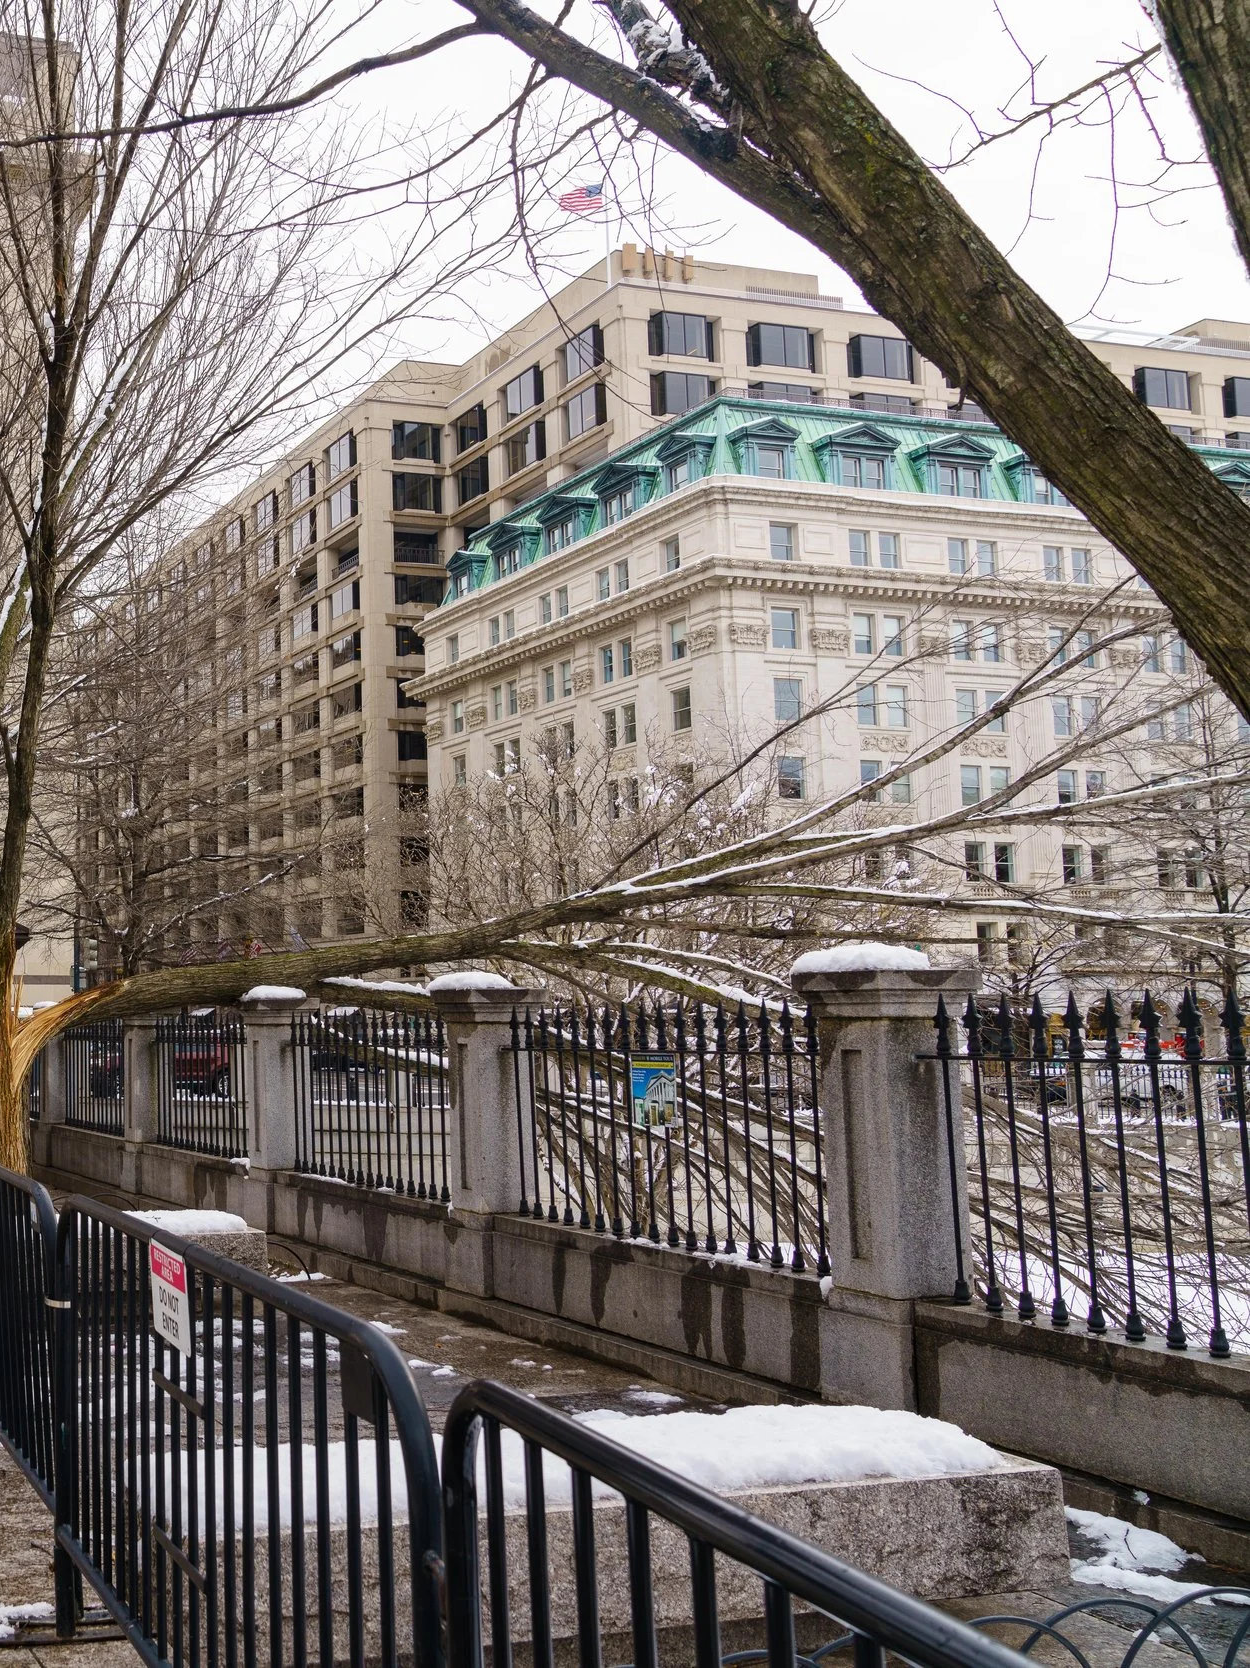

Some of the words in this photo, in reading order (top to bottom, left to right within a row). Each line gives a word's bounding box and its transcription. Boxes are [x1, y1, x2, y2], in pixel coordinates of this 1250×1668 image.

[153, 1247, 181, 1275] RESTRICTED
[161, 1264, 174, 1283] AREA
[159, 1285, 167, 1306] DO
[167, 1293, 179, 1316] NOT
[162, 1311, 180, 1340] ENTER
